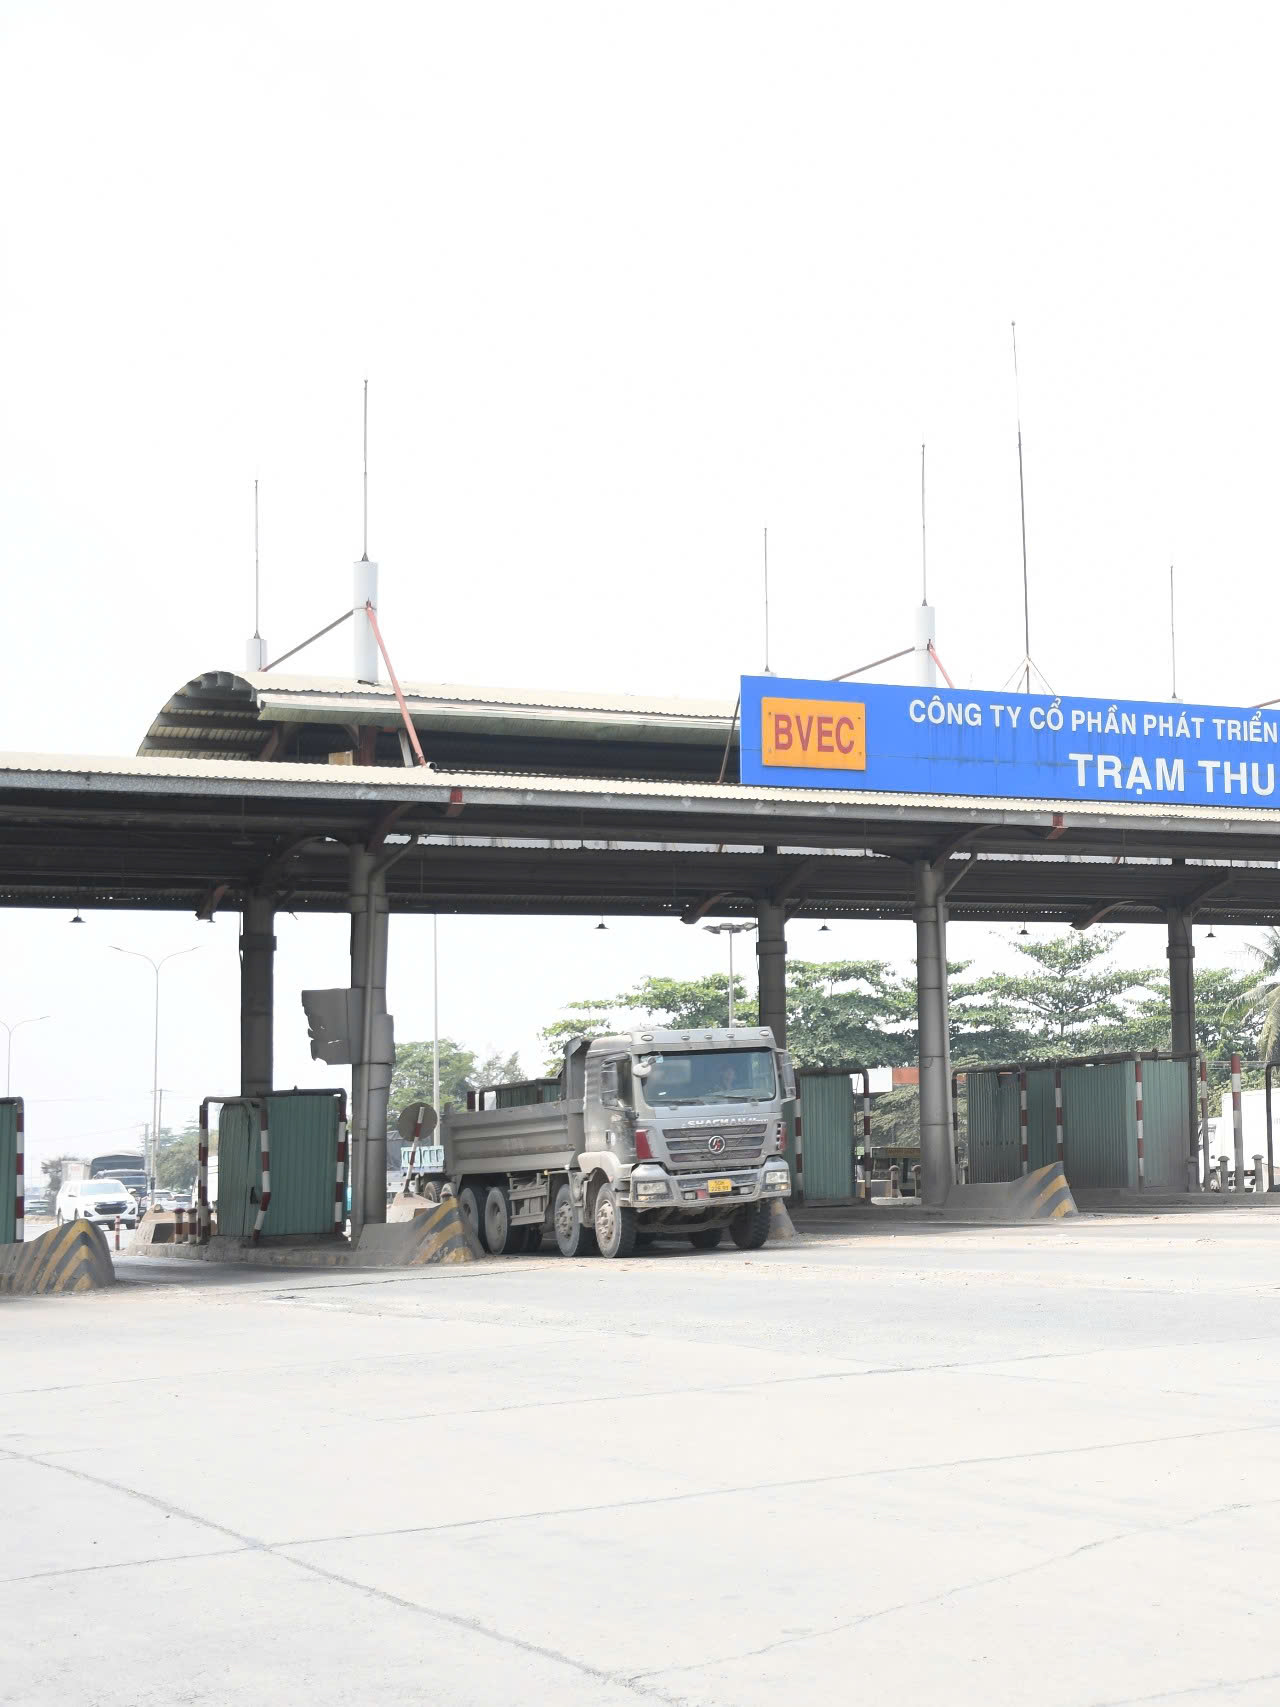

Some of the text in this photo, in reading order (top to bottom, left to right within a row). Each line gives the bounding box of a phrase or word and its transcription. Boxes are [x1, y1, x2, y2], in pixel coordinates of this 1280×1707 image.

[774, 714, 854, 755] BVEC
[909, 695, 982, 727] CÔNG
[989, 704, 1021, 728] TY
[1029, 697, 1064, 731] CỔ
[1071, 704, 1137, 735] PHẦN
[1143, 711, 1205, 739] PHÁT
[1212, 711, 1278, 743] TRIỂN
[1068, 753, 1185, 795] TRẠM
[1197, 760, 1275, 796] THU
